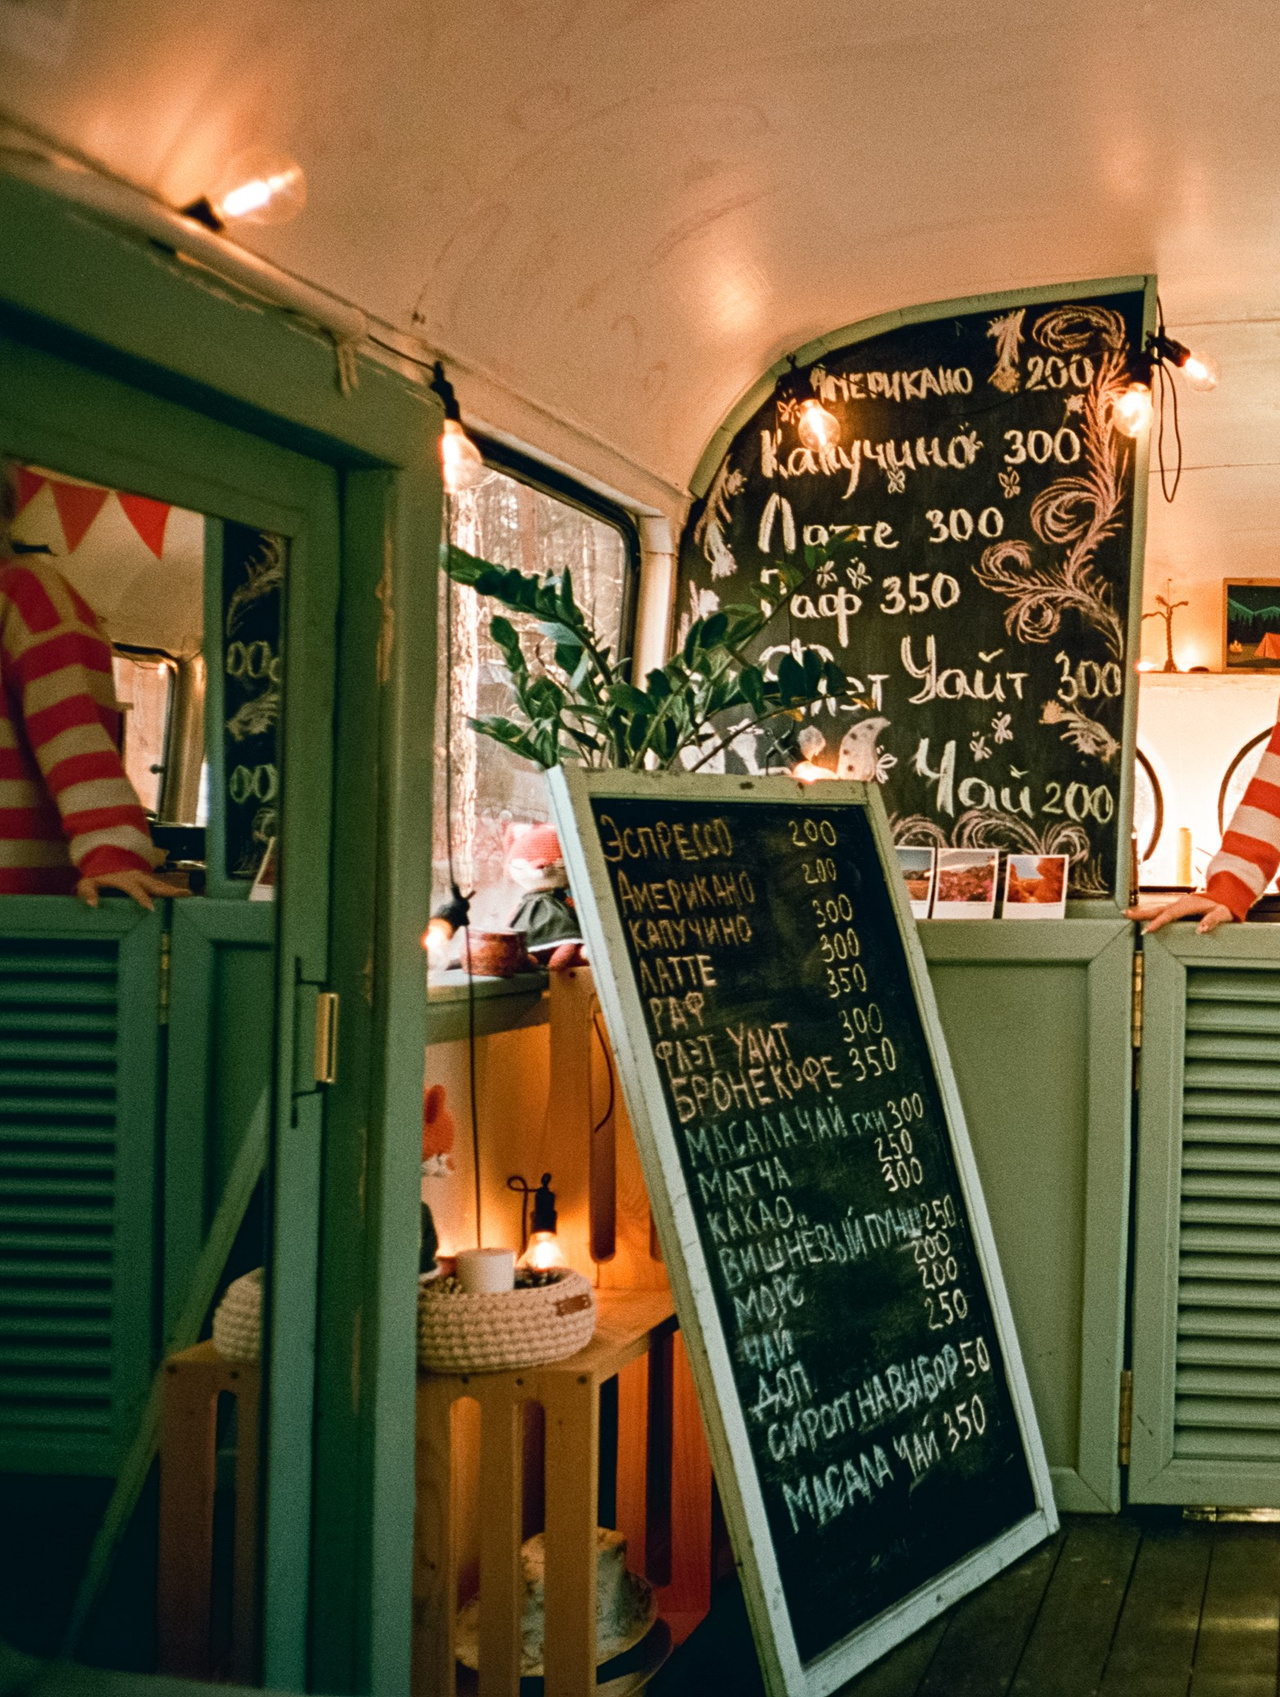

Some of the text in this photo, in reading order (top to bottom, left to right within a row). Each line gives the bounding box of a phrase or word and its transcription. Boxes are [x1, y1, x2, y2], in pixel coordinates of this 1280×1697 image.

[1025, 354, 1095, 391] 200
[1003, 428, 1081, 465] 300
[925, 506, 1005, 544] 300
[879, 571, 960, 616] 350
[900, 634, 1030, 705] Уайт
[1055, 650, 1124, 702] 300
[914, 736, 1115, 824] Чай 200
[788, 818, 837, 847] 200
[802, 858, 837, 884] 200
[628, 893, 853, 954] КАПУЧИНО 300
[639, 928, 860, 997] ЛАТТЕ 300
[650, 963, 867, 1037] РАФ 350
[838, 1003, 883, 1042] 300
[849, 1037, 896, 1081] 350
[684, 1110, 798, 1168] МАСАЛА
[795, 1096, 848, 1142] ЧАЙ
[887, 1093, 924, 1129] 300
[697, 1129, 913, 1205] МАТЧА 250
[706, 1156, 923, 1243] КАКАО 300
[920, 1195, 957, 1229] 250
[734, 1230, 950, 1334] МОРС 200
[918, 1257, 958, 1290] 200
[924, 1288, 968, 1330] 250
[767, 1391, 854, 1461] СИРОП
[855, 1374, 892, 1423] НА
[959, 1336, 990, 1377] 50
[782, 1445, 894, 1534] МАСАЛА
[943, 1394, 986, 1452] 350
